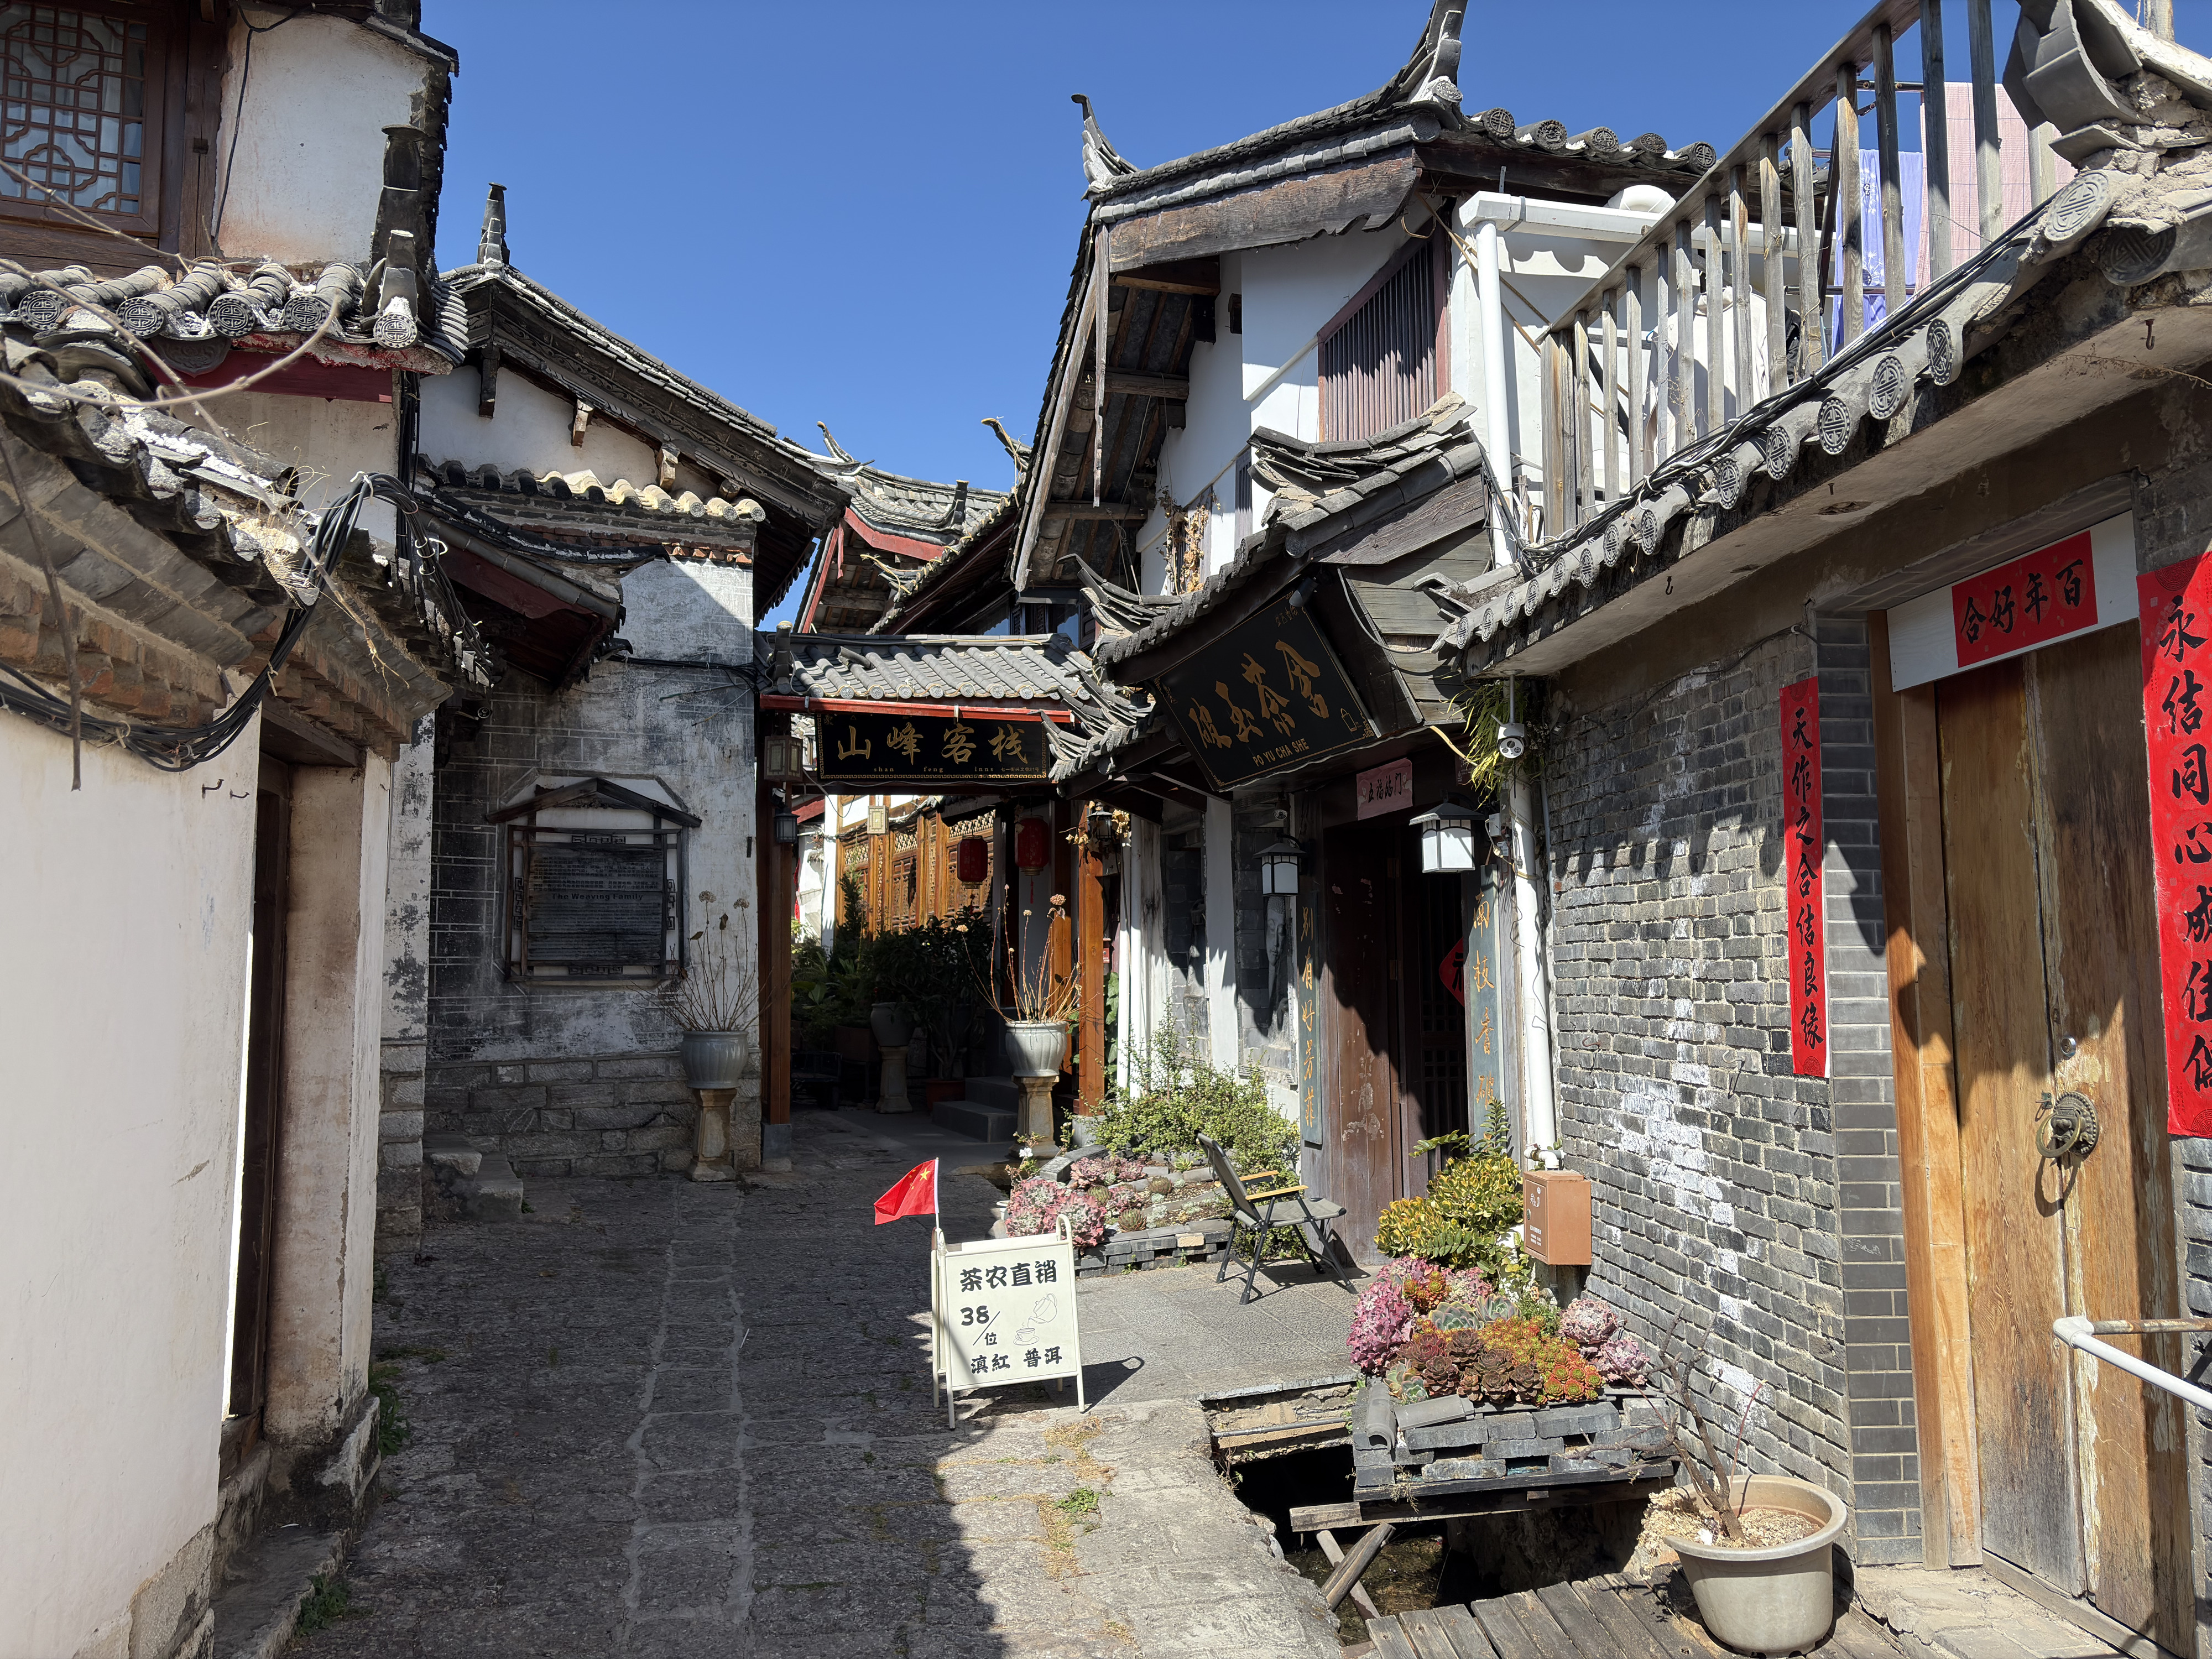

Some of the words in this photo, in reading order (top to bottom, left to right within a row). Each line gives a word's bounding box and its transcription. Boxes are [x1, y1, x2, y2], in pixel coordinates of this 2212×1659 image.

[1960, 559, 2084, 644] 百年好合
[838, 722, 1028, 765] 山峰客栈
[1252, 755, 1265, 767] PO
[1262, 750, 1276, 763] YU
[1275, 744, 1293, 759] CHA
[1291, 738, 1310, 753] SHE
[1791, 707, 1824, 1050] 天作之合结良缘
[1473, 888, 1495, 1152] 南枝香破
[959, 1260, 1057, 1292] 茶农直销
